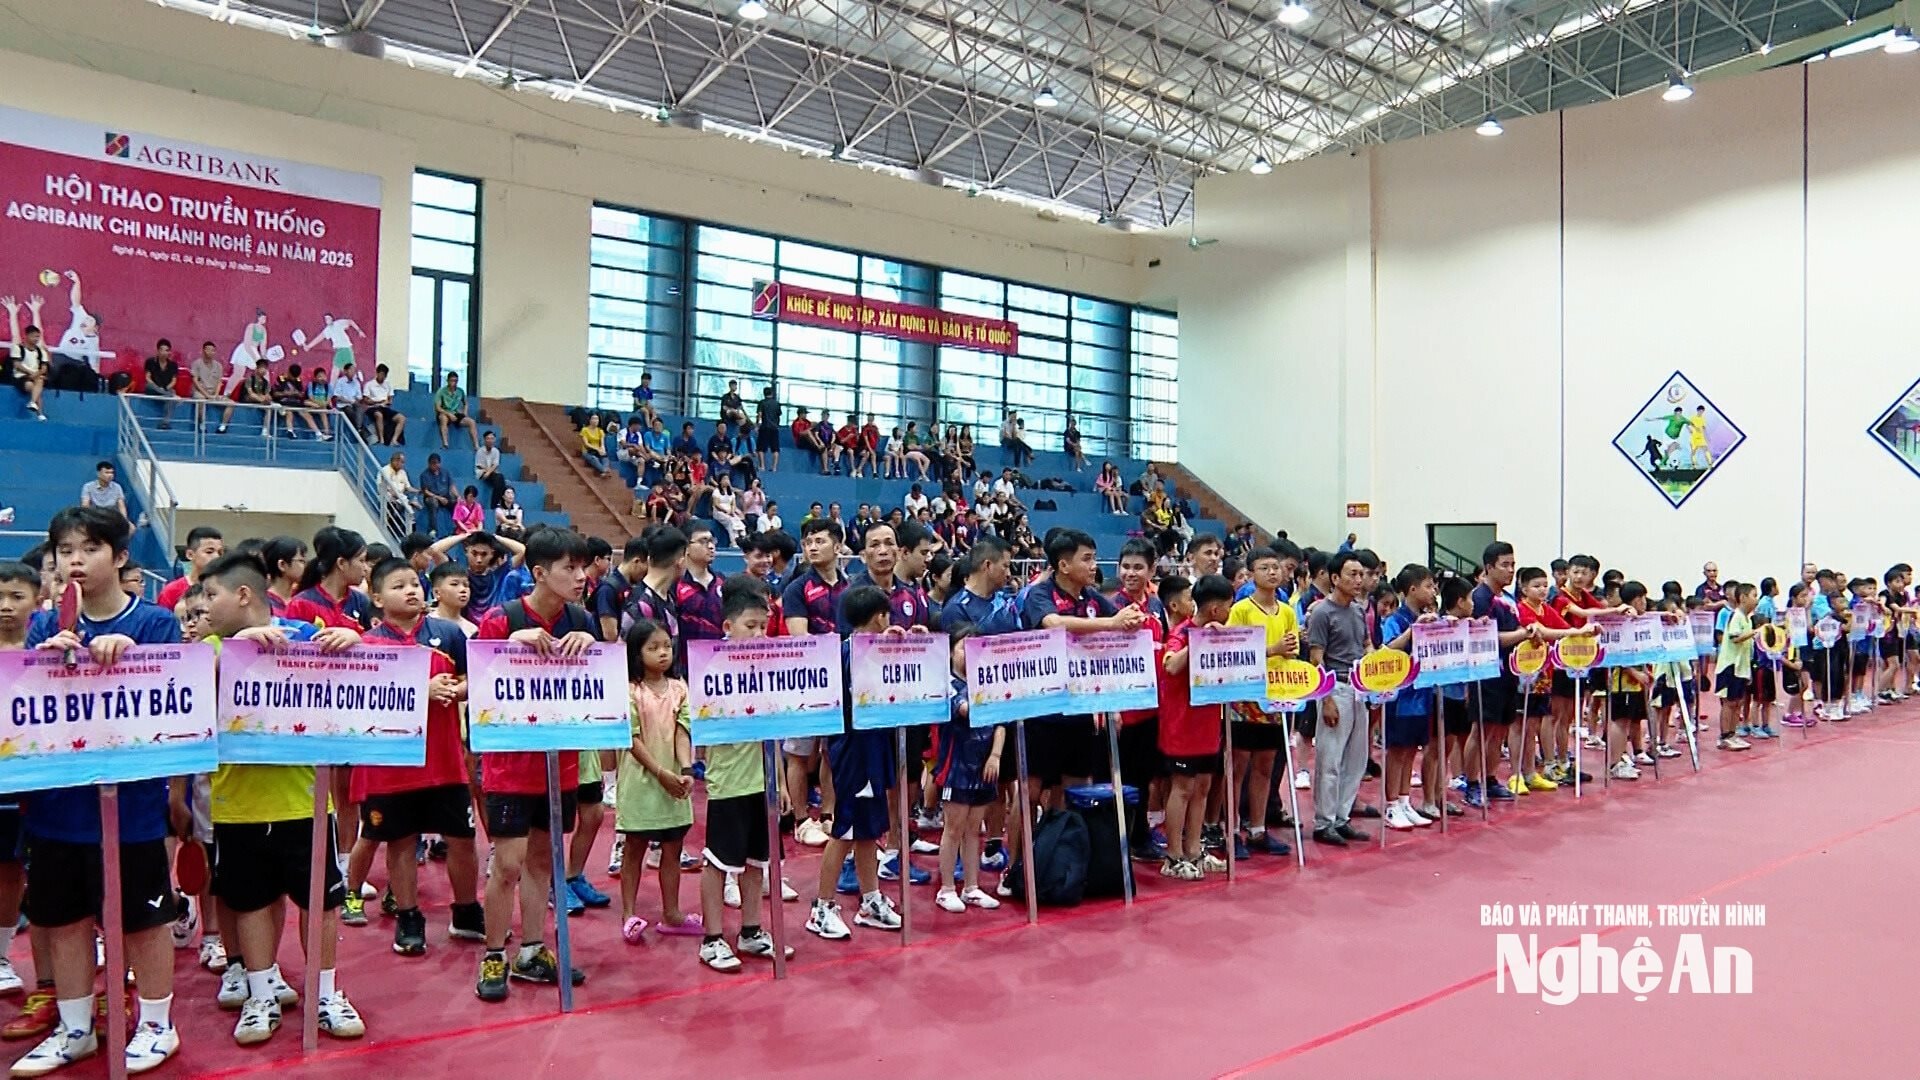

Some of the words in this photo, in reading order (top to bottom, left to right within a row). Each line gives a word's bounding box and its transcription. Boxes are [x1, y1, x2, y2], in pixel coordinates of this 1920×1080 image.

[136, 144, 281, 186] AGRIBANK
[45, 173, 92, 204] HỘI
[99, 184, 164, 213] THAO
[169, 195, 248, 227] TRUYỀN
[254, 208, 326, 238] THỐNG
[6, 201, 104, 232] AGRIBANK
[108, 217, 141, 238] CHI
[145, 222, 205, 247] NHÁNH
[209, 234, 252, 257] NGHỆ
[256, 238, 278, 257] AN
[282, 240, 316, 263] NĂM
[320, 249, 354, 268] 2025
[786, 293, 814, 314] KHỎE
[833, 304, 854, 324] HỌC
[856, 306, 876, 328] TẬP,
[879, 308, 897, 327] XÂY
[900, 316, 925, 335] DỰNG
[927, 317, 941, 335] VÀ
[942, 317, 961, 338] BẢO
[963, 323, 974, 343] VỆ
[975, 322, 987, 342] TỔ
[988, 325, 1012, 346] QUỐC
[1068, 660, 1087, 679] CLB
[1090, 657, 1110, 677] ANH
[1112, 652, 1145, 675] HOÀNG
[1200, 653, 1215, 670] CLB
[1217, 650, 1256, 668] HERMANN
[1417, 645, 1428, 658] CLB
[704, 673, 733, 697] CLB
[738, 665, 763, 694] HẢI
[768, 667, 828, 694] THƯỢNG
[882, 663, 901, 684] CLB
[904, 663, 922, 682] NV1
[978, 665, 999, 686] B&T
[1038, 656, 1058, 677] LƯU
[1286, 668, 1309, 687] NGHỆ
[12, 695, 58, 726] CLB
[65, 693, 95, 722] BV
[101, 685, 142, 720] TÂY
[150, 678, 193, 716] BẮC
[233, 680, 261, 706] CLB
[265, 674, 303, 708] TUẤN
[306, 680, 332, 709] TRÀ
[337, 683, 365, 710] CON
[369, 681, 416, 711] CUÔNG
[495, 677, 525, 700] CLB
[530, 677, 567, 700] NAM
[572, 674, 604, 700] ĐÀN
